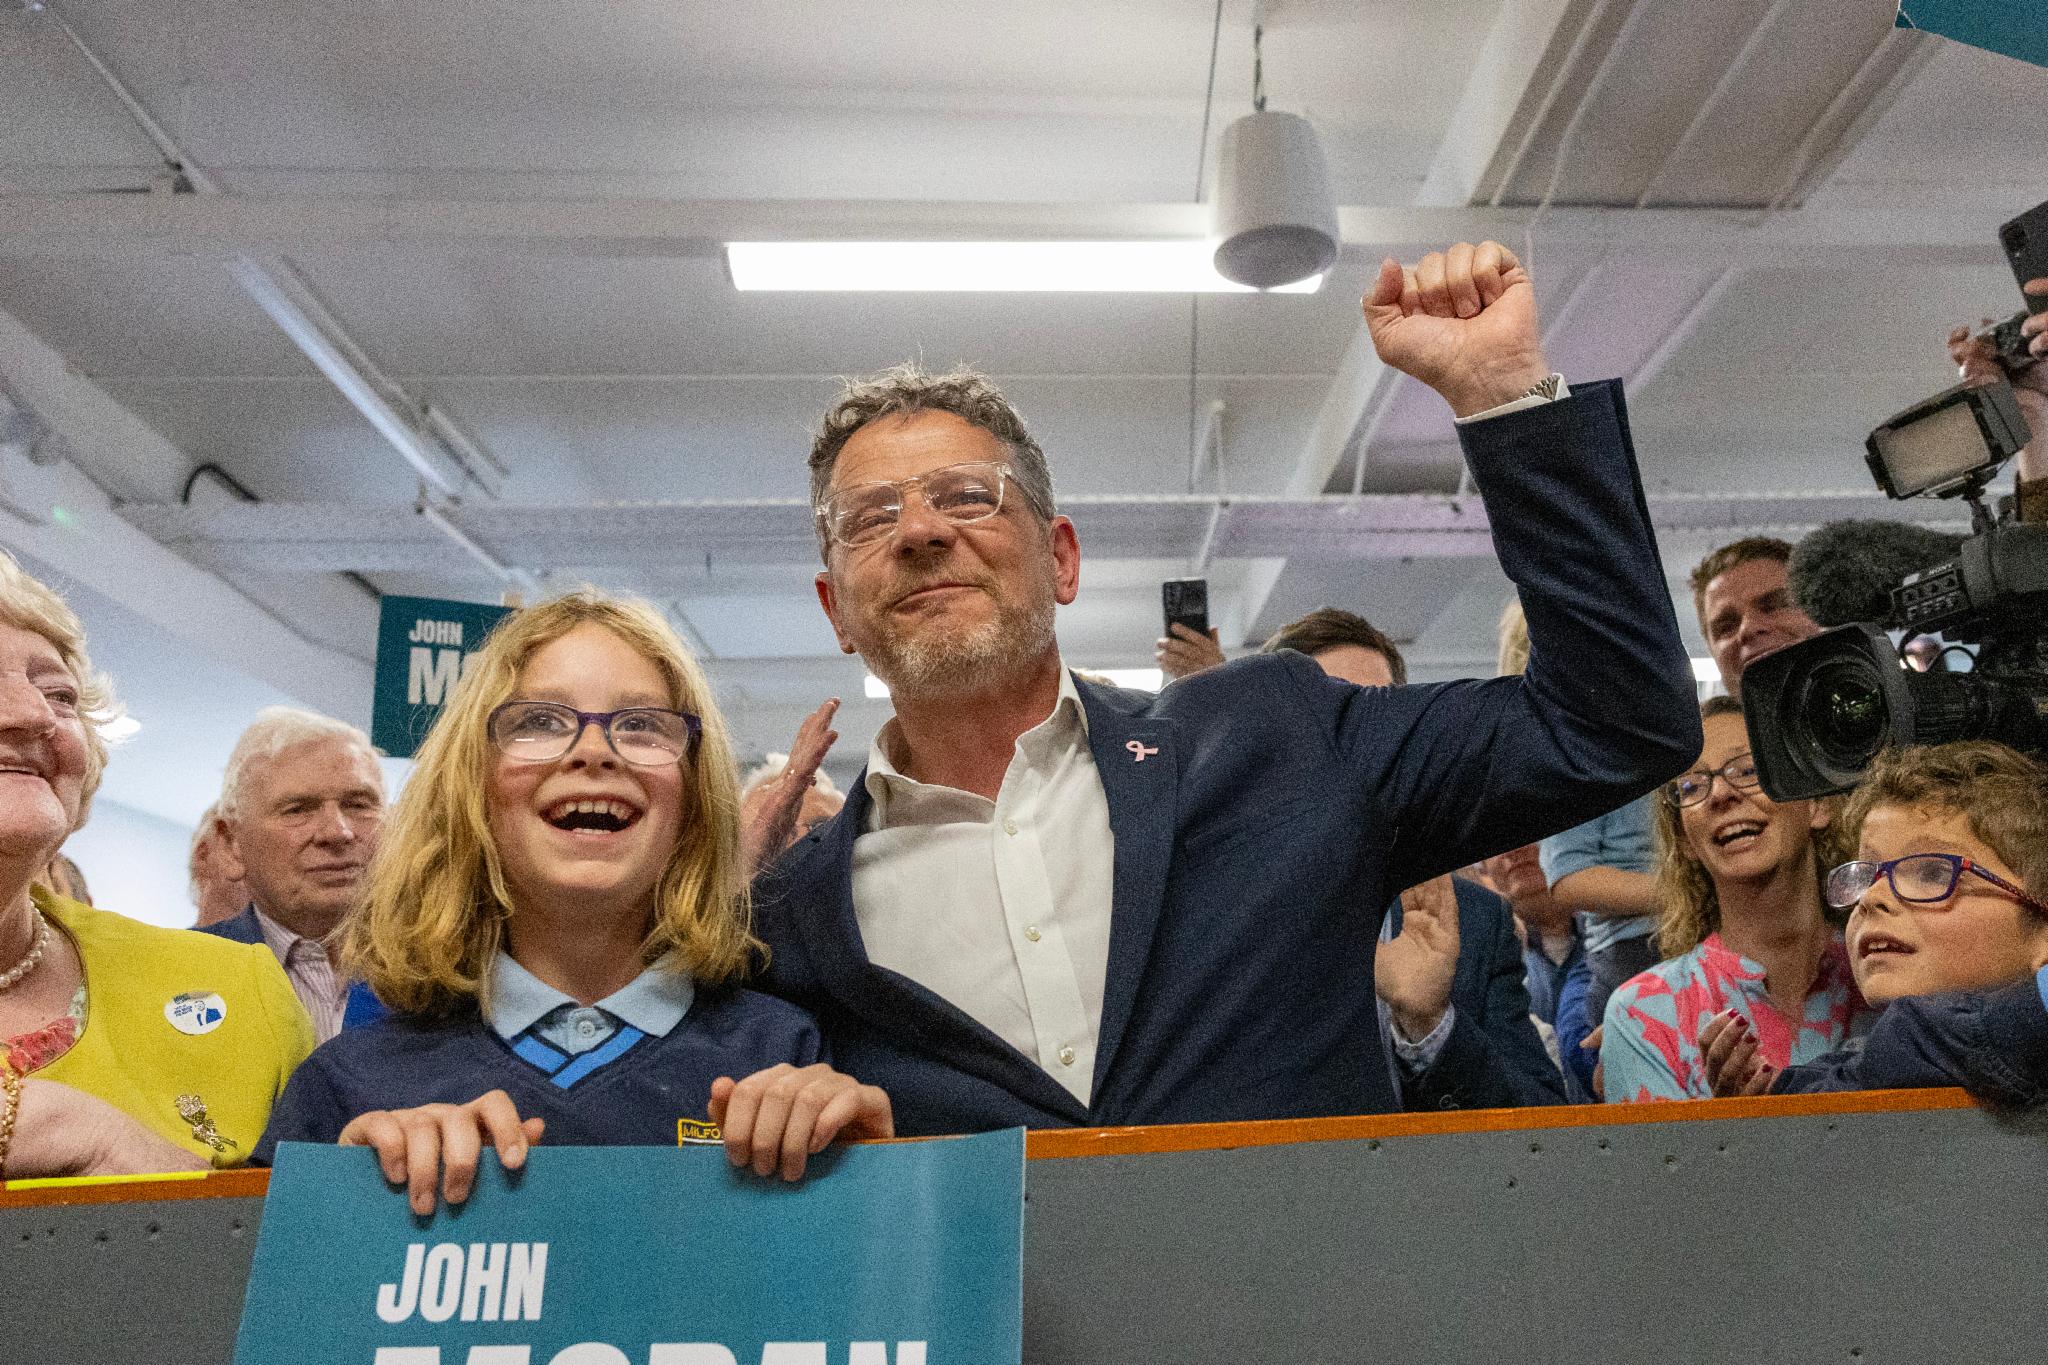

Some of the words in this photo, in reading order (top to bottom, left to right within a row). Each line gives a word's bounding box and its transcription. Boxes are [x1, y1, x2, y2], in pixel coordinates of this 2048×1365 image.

[409, 619, 463, 646] JOHN
[408, 647, 480, 705] M
[682, 1125, 722, 1139] MILFO
[376, 1242, 549, 1324] JOHN
